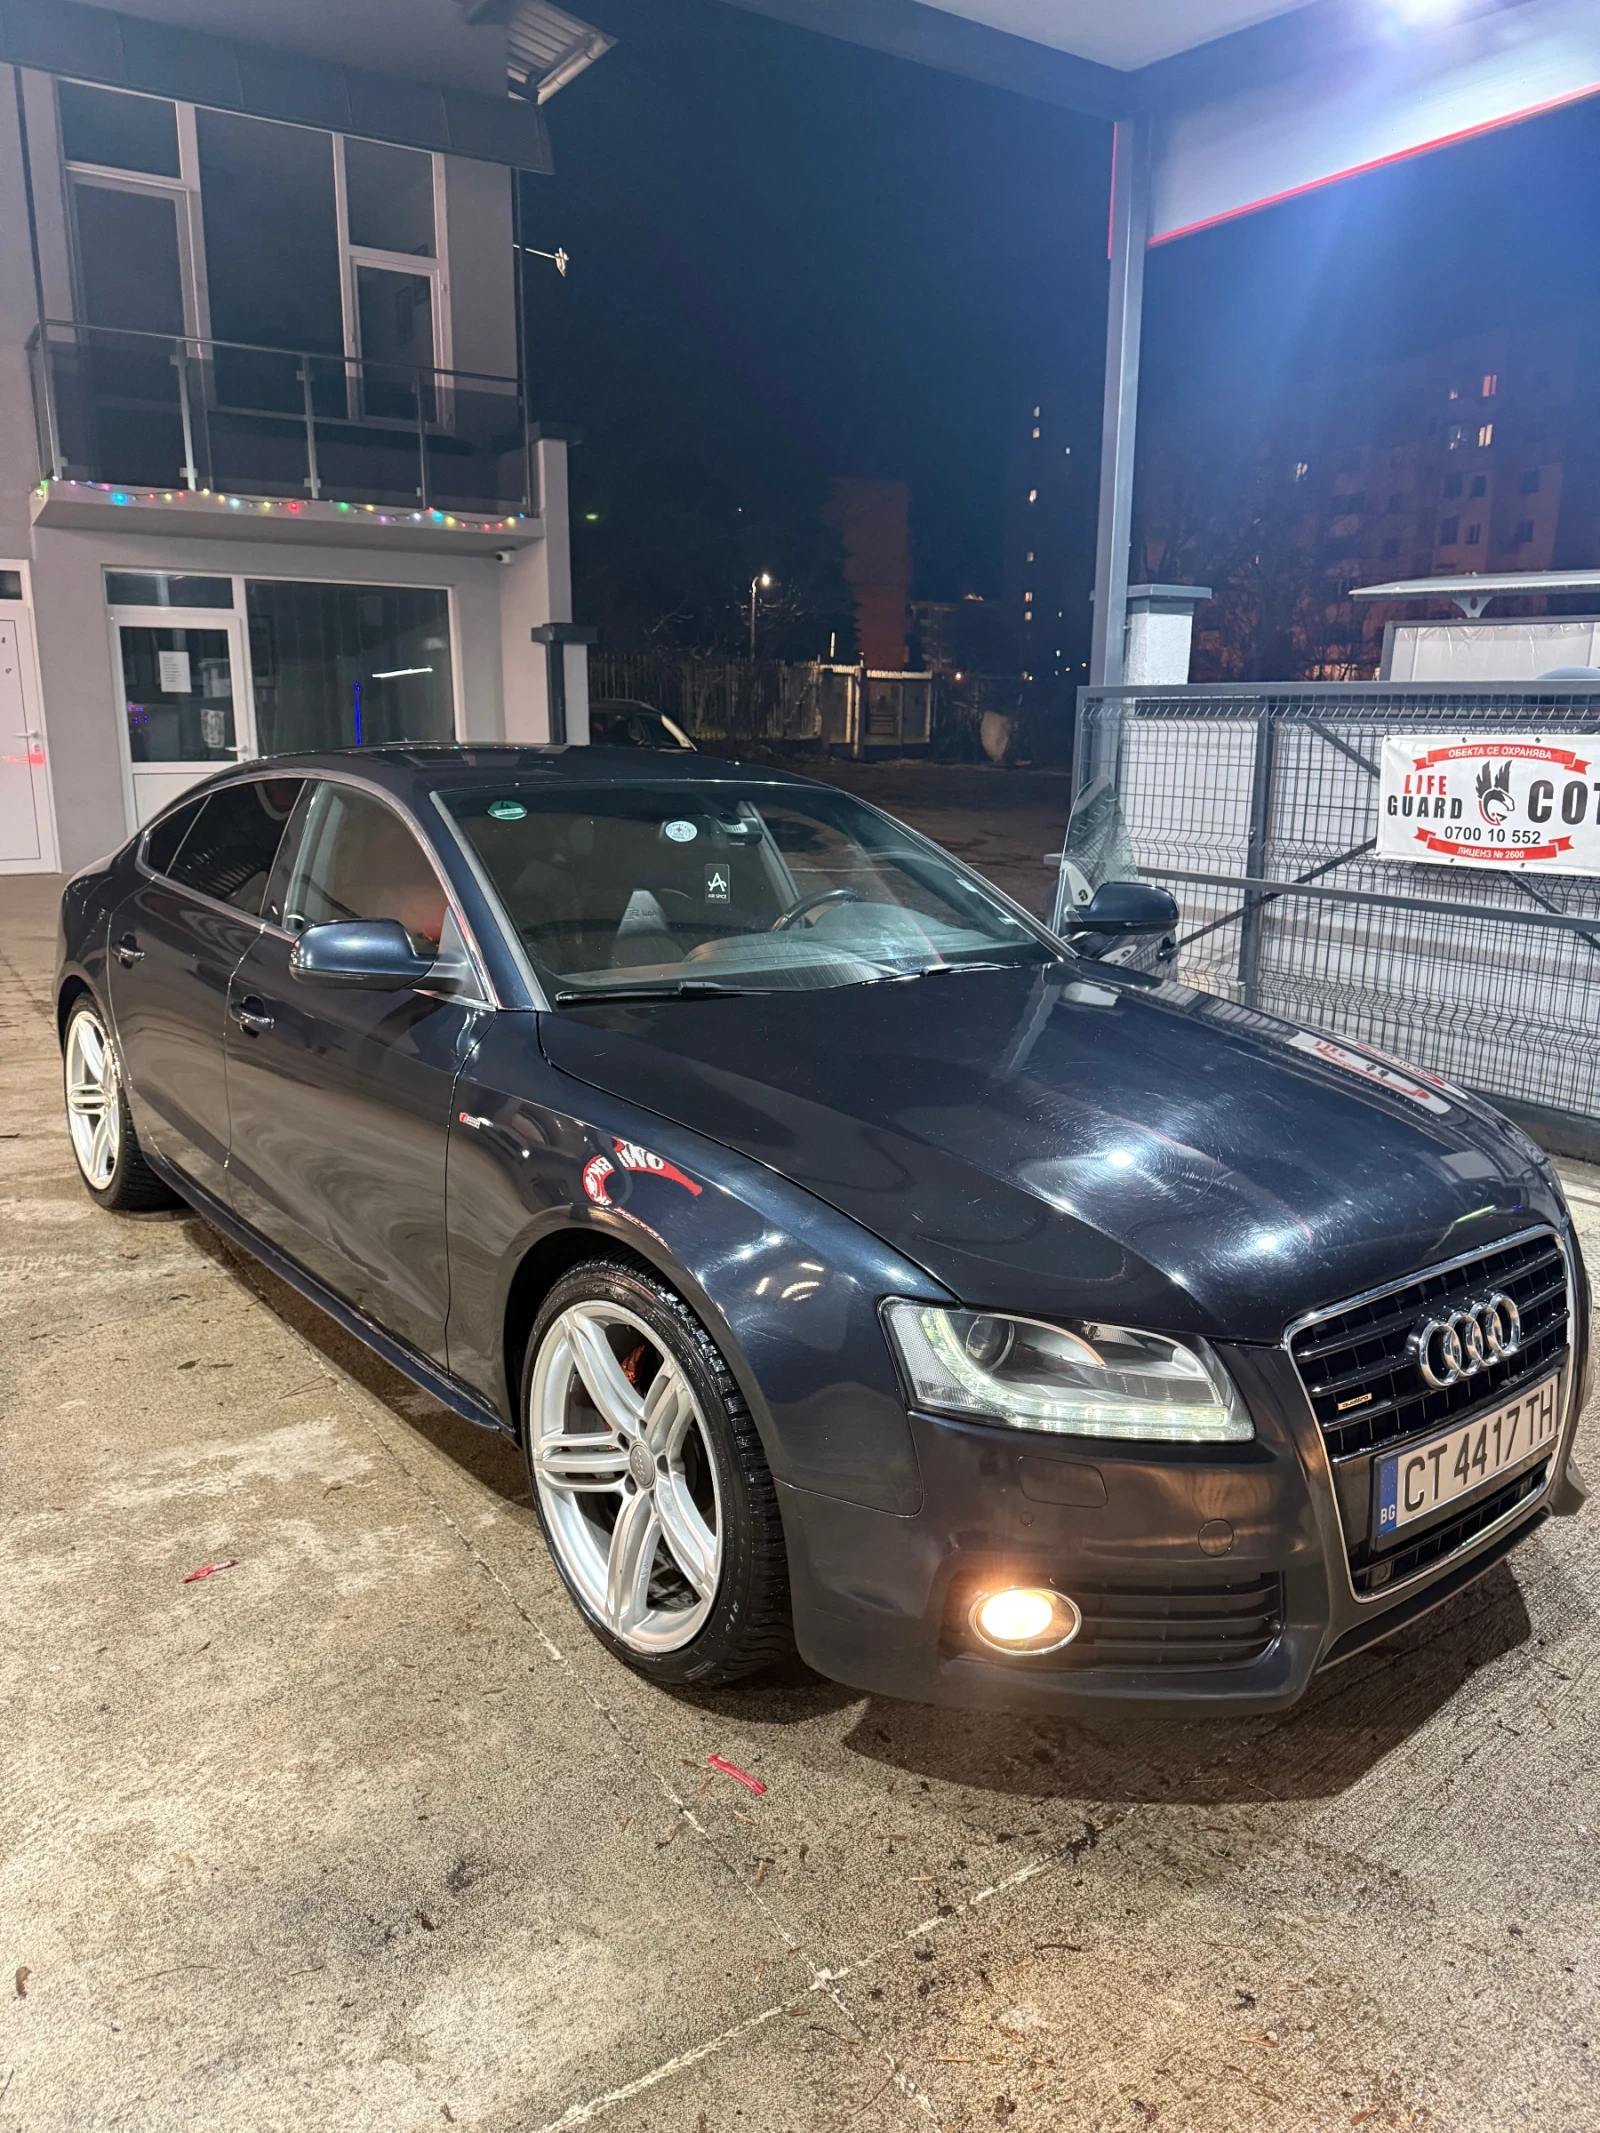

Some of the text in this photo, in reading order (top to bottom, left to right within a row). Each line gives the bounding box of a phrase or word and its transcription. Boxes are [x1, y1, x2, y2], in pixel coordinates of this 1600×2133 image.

[1448, 746, 1552, 759] ОБЕКТА СЕ ОХРАНЯВА
[1404, 774, 1447, 796] LIFE
[1387, 794, 1463, 820] GUARD
[1527, 780, 1600, 825] СО
[1444, 825, 1541, 845] 0700 10 552
[1457, 846, 1491, 858] ЛИЦЕНЗ
[1505, 850, 1525, 859] 2600
[1404, 1384, 1553, 1512] CT 4417 TH
[1380, 1504, 1396, 1525] BG
